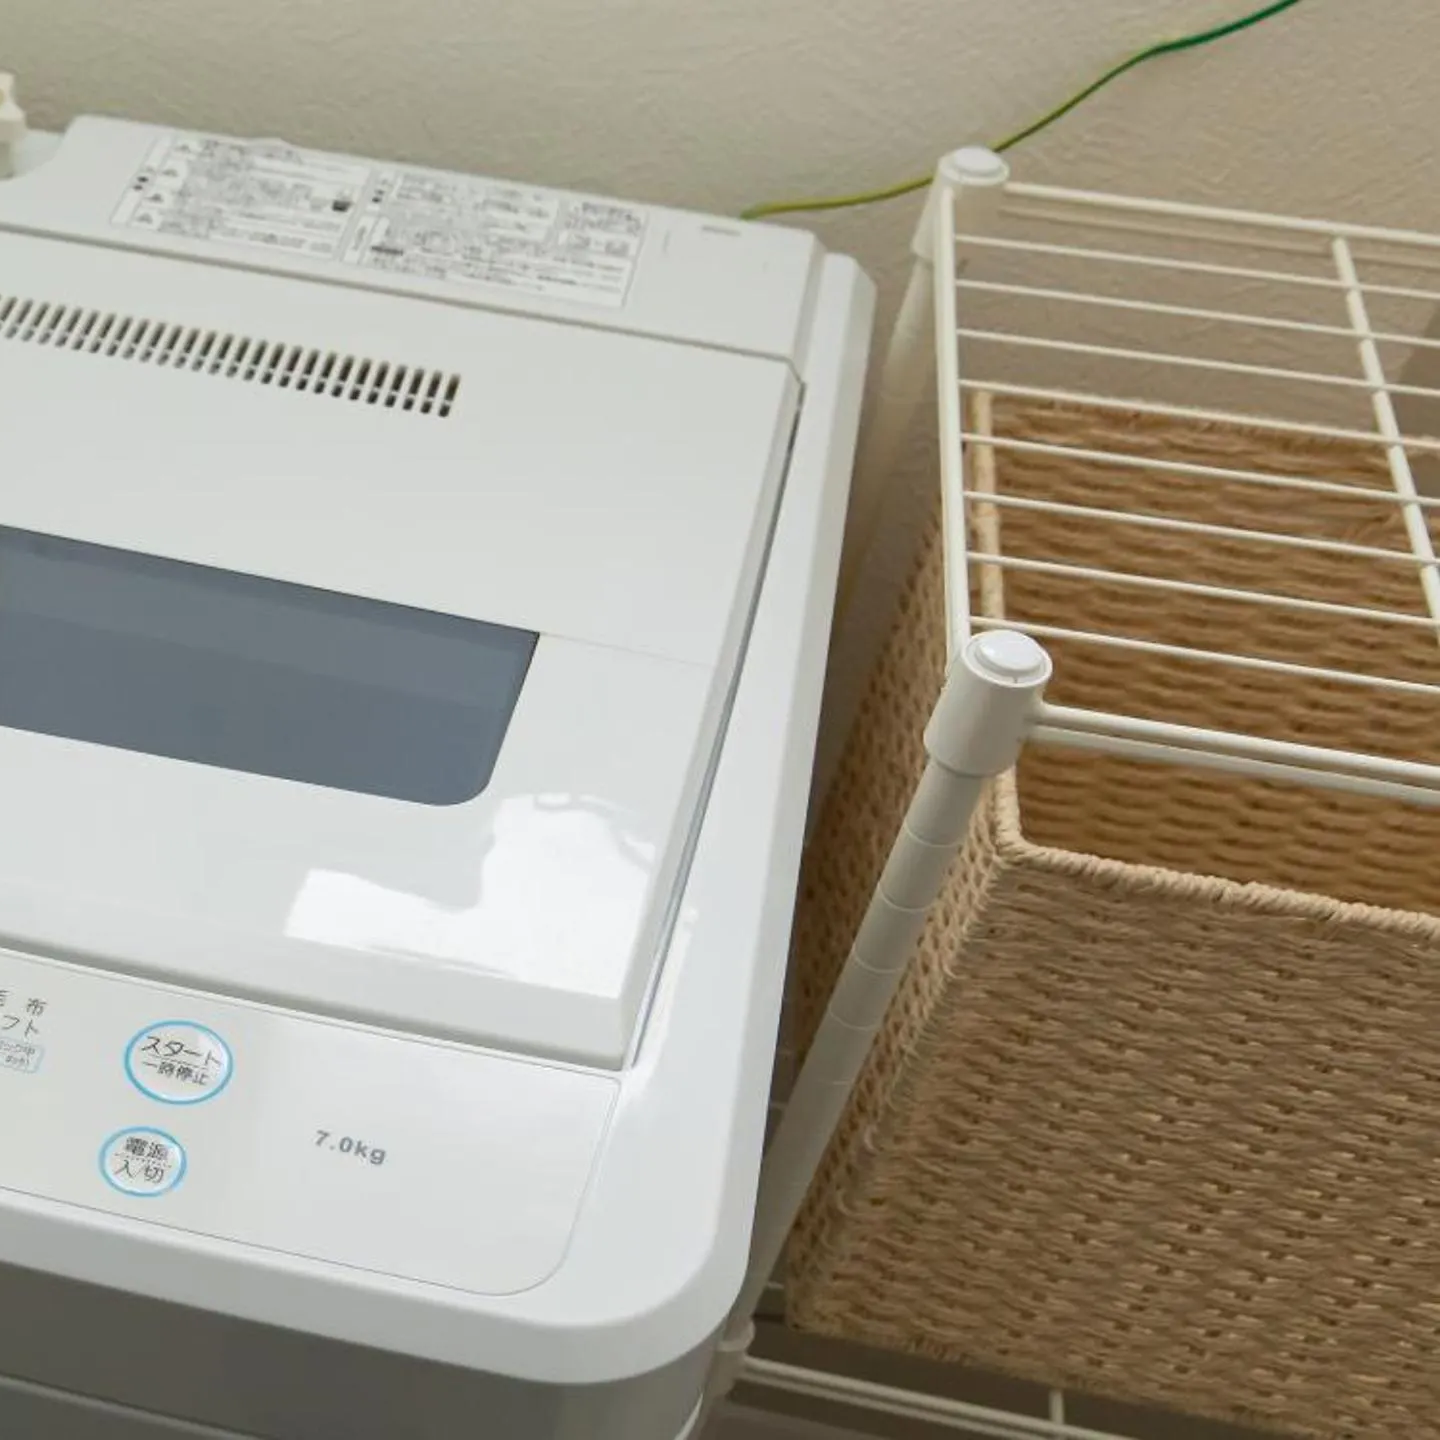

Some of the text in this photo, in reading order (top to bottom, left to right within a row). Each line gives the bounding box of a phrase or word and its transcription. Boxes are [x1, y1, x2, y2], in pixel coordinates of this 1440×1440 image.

[141, 1035, 223, 1067] スタート
[314, 1129, 387, 1166] 7.0kg
